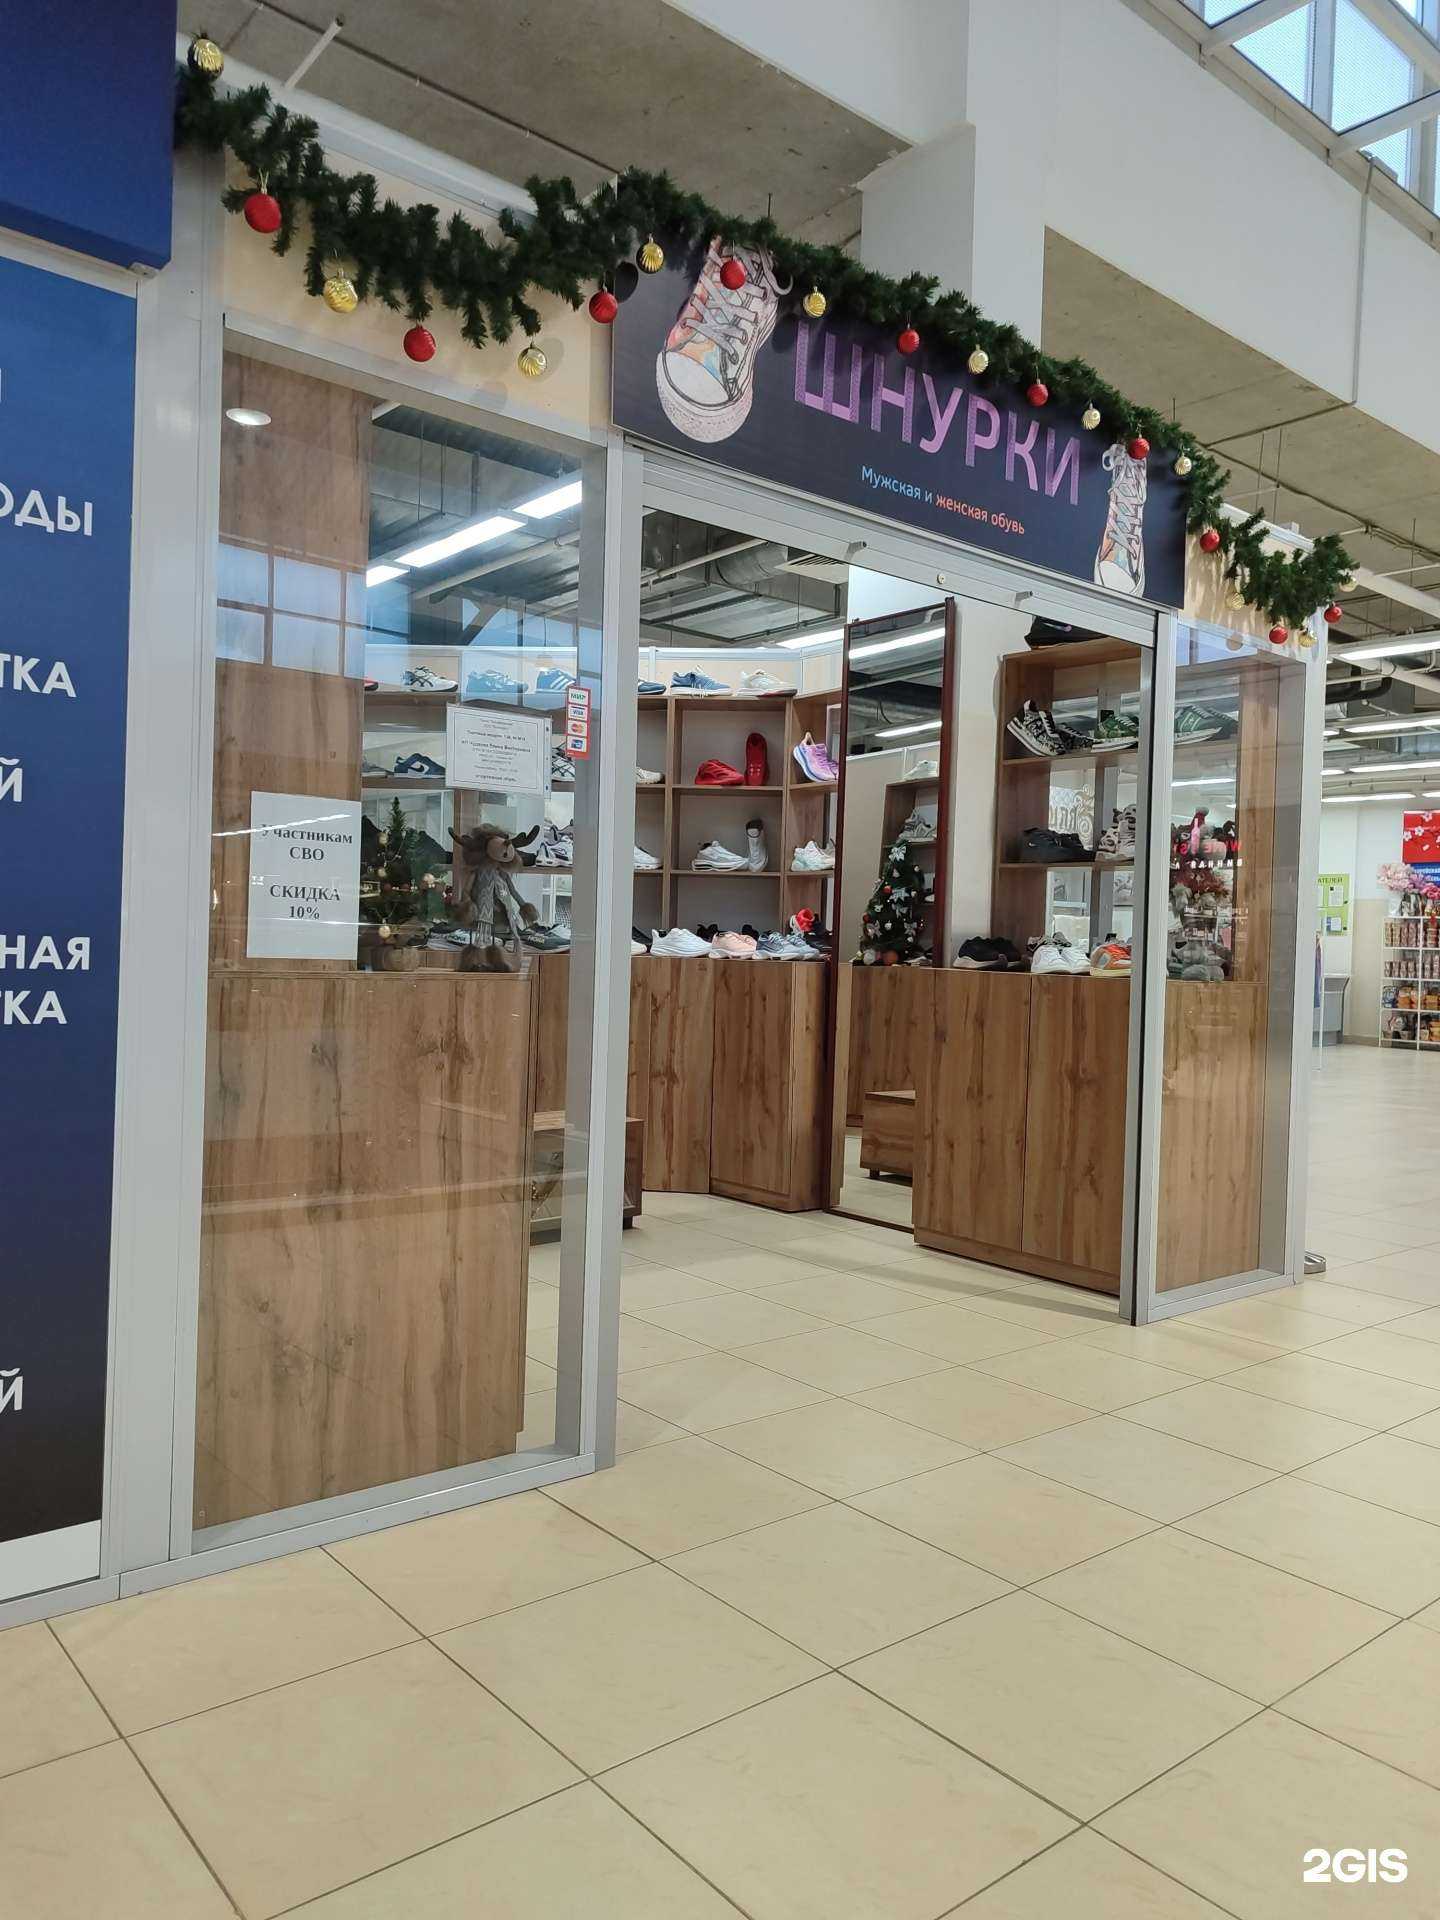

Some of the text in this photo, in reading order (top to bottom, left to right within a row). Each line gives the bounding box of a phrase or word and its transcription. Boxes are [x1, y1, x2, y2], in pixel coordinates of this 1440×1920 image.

[794, 320, 1081, 506] ШНУРКИ
[861, 465, 1025, 535] Мужская и женская обувь
[261, 823, 353, 844] Участникам
[289, 846, 325, 861] СВО
[270, 883, 341, 903] СКИДКА
[288, 905, 320, 920] 10%
[0, 934, 91, 971] НАЯ
[0, 990, 68, 1025] КА
